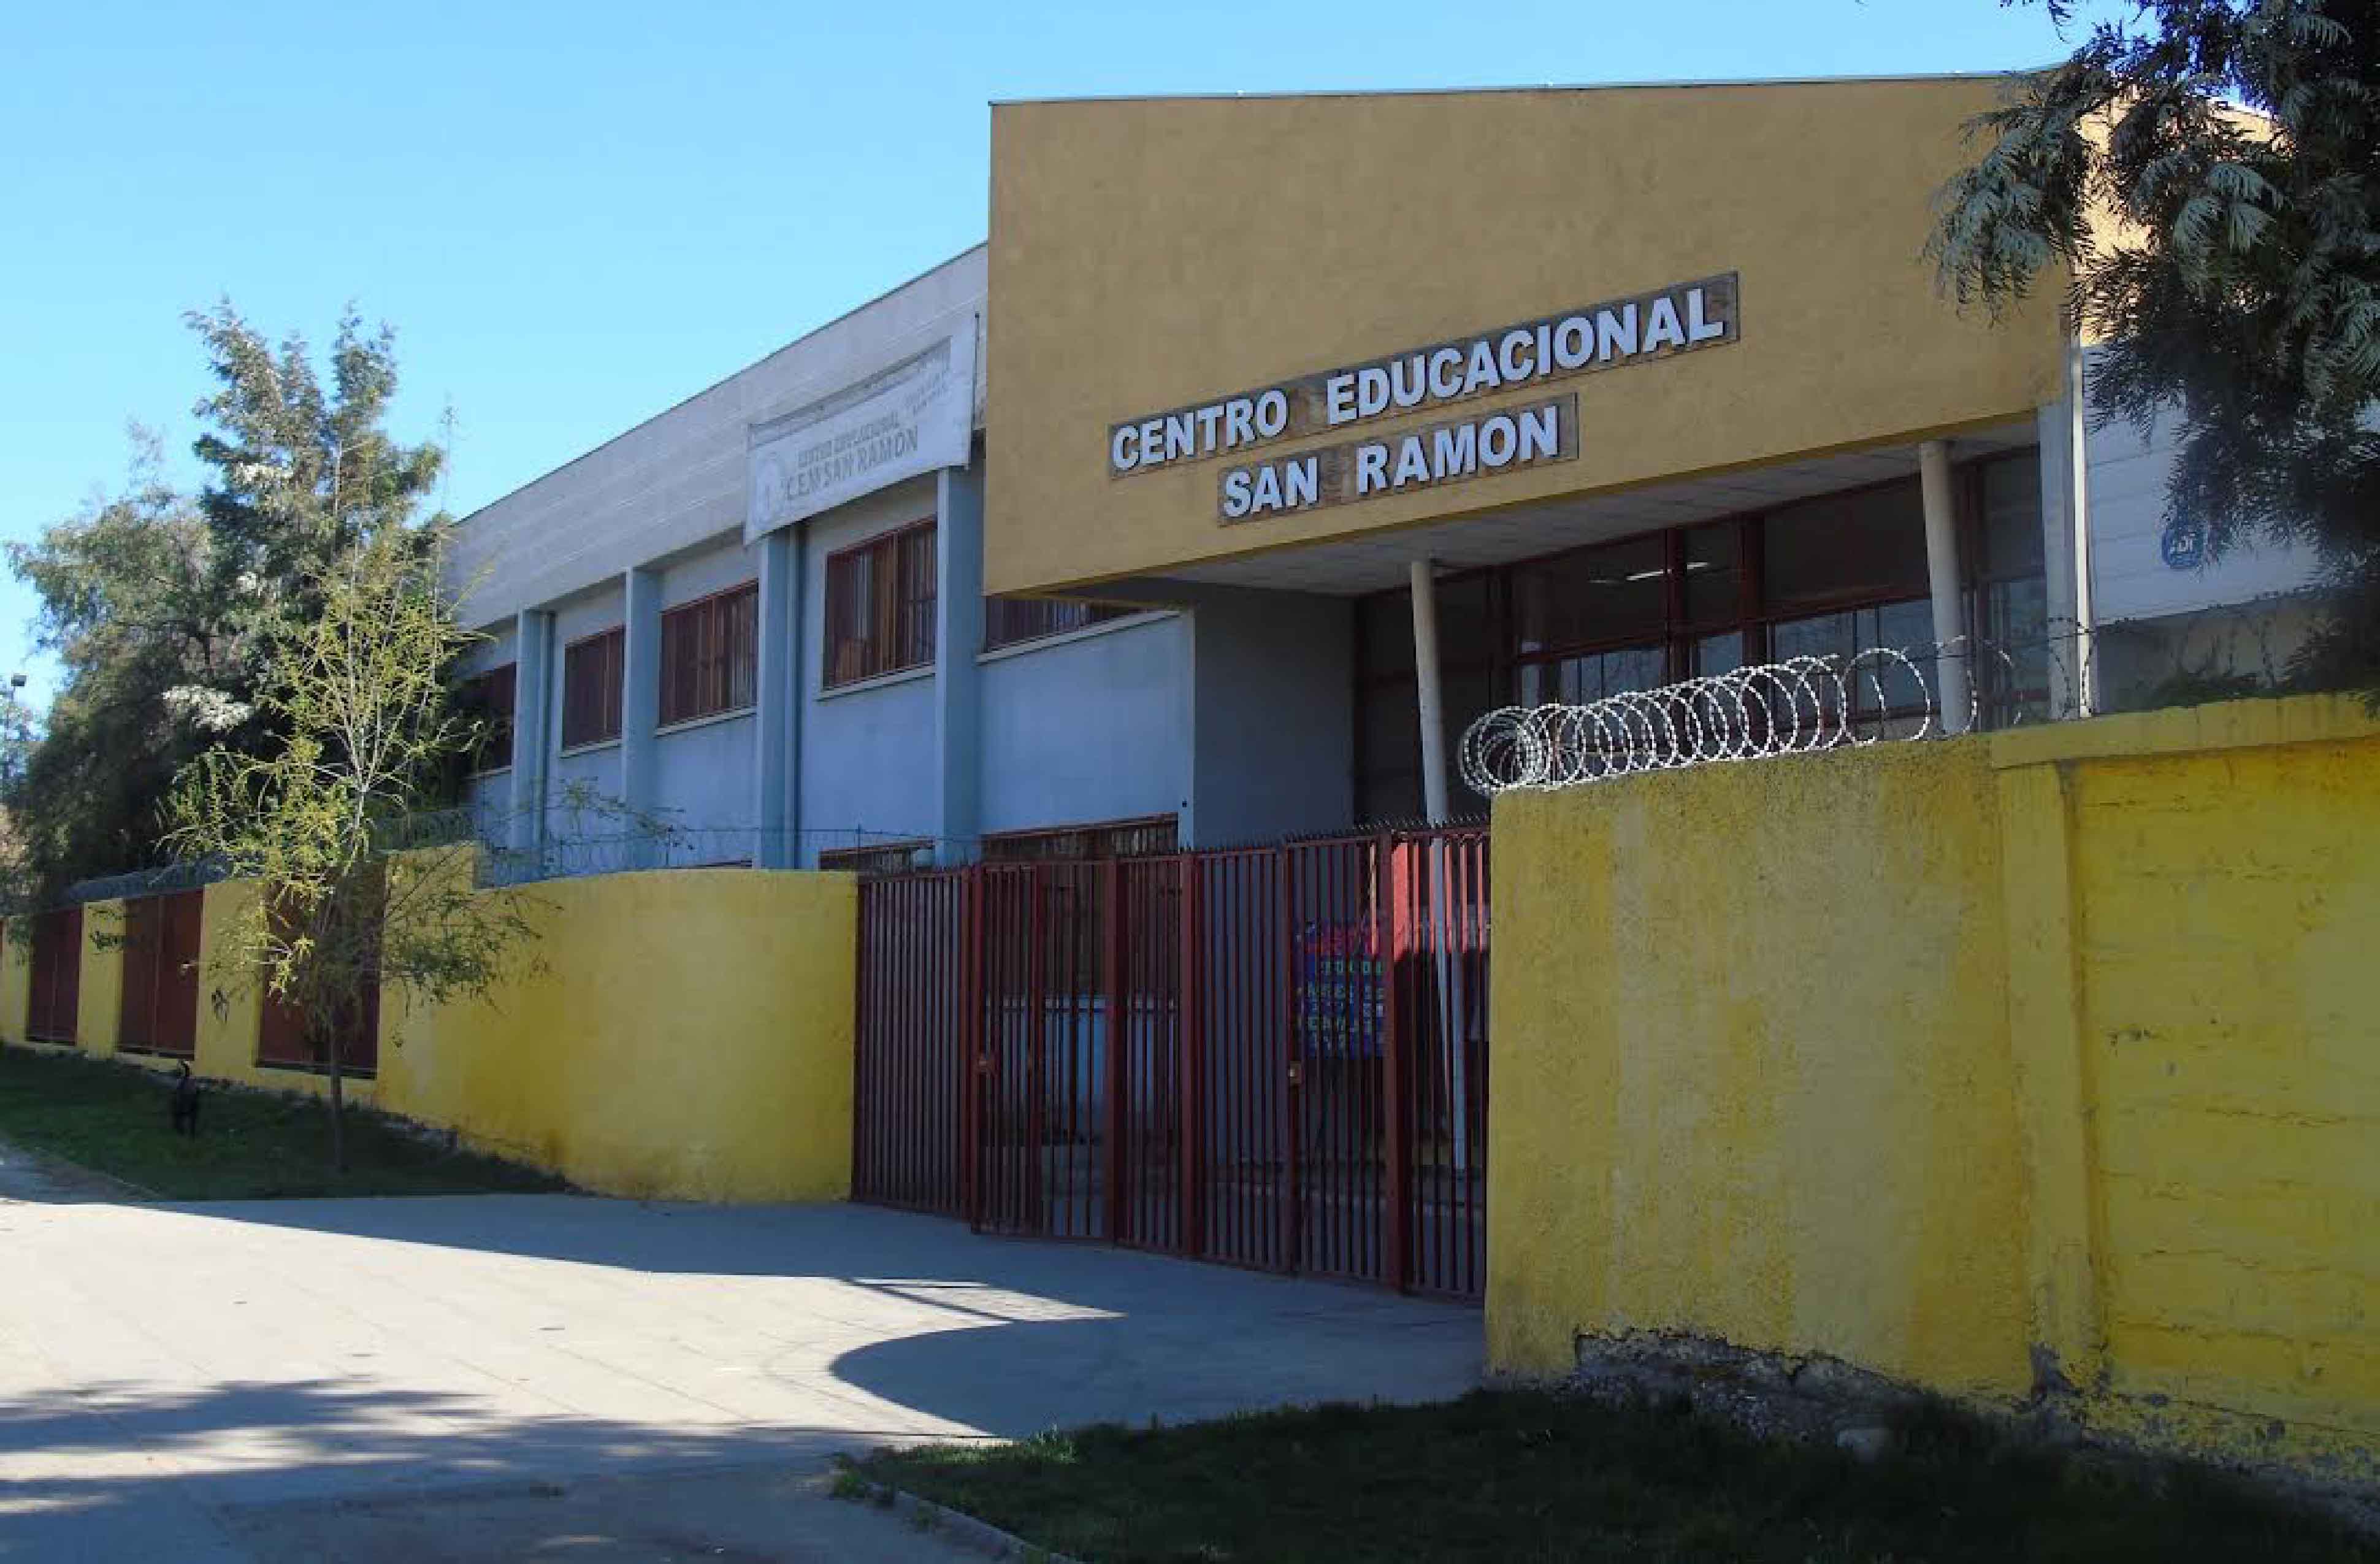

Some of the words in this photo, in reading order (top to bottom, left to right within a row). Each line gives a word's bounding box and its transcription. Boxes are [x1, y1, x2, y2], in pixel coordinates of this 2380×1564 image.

[1111, 389, 1287, 471] CENTRO
[1326, 288, 1724, 424] EDUCACIONAL
[857, 424, 918, 475] RAMON
[1223, 456, 1318, 518] SAN
[1356, 405, 1558, 494] RAMON
